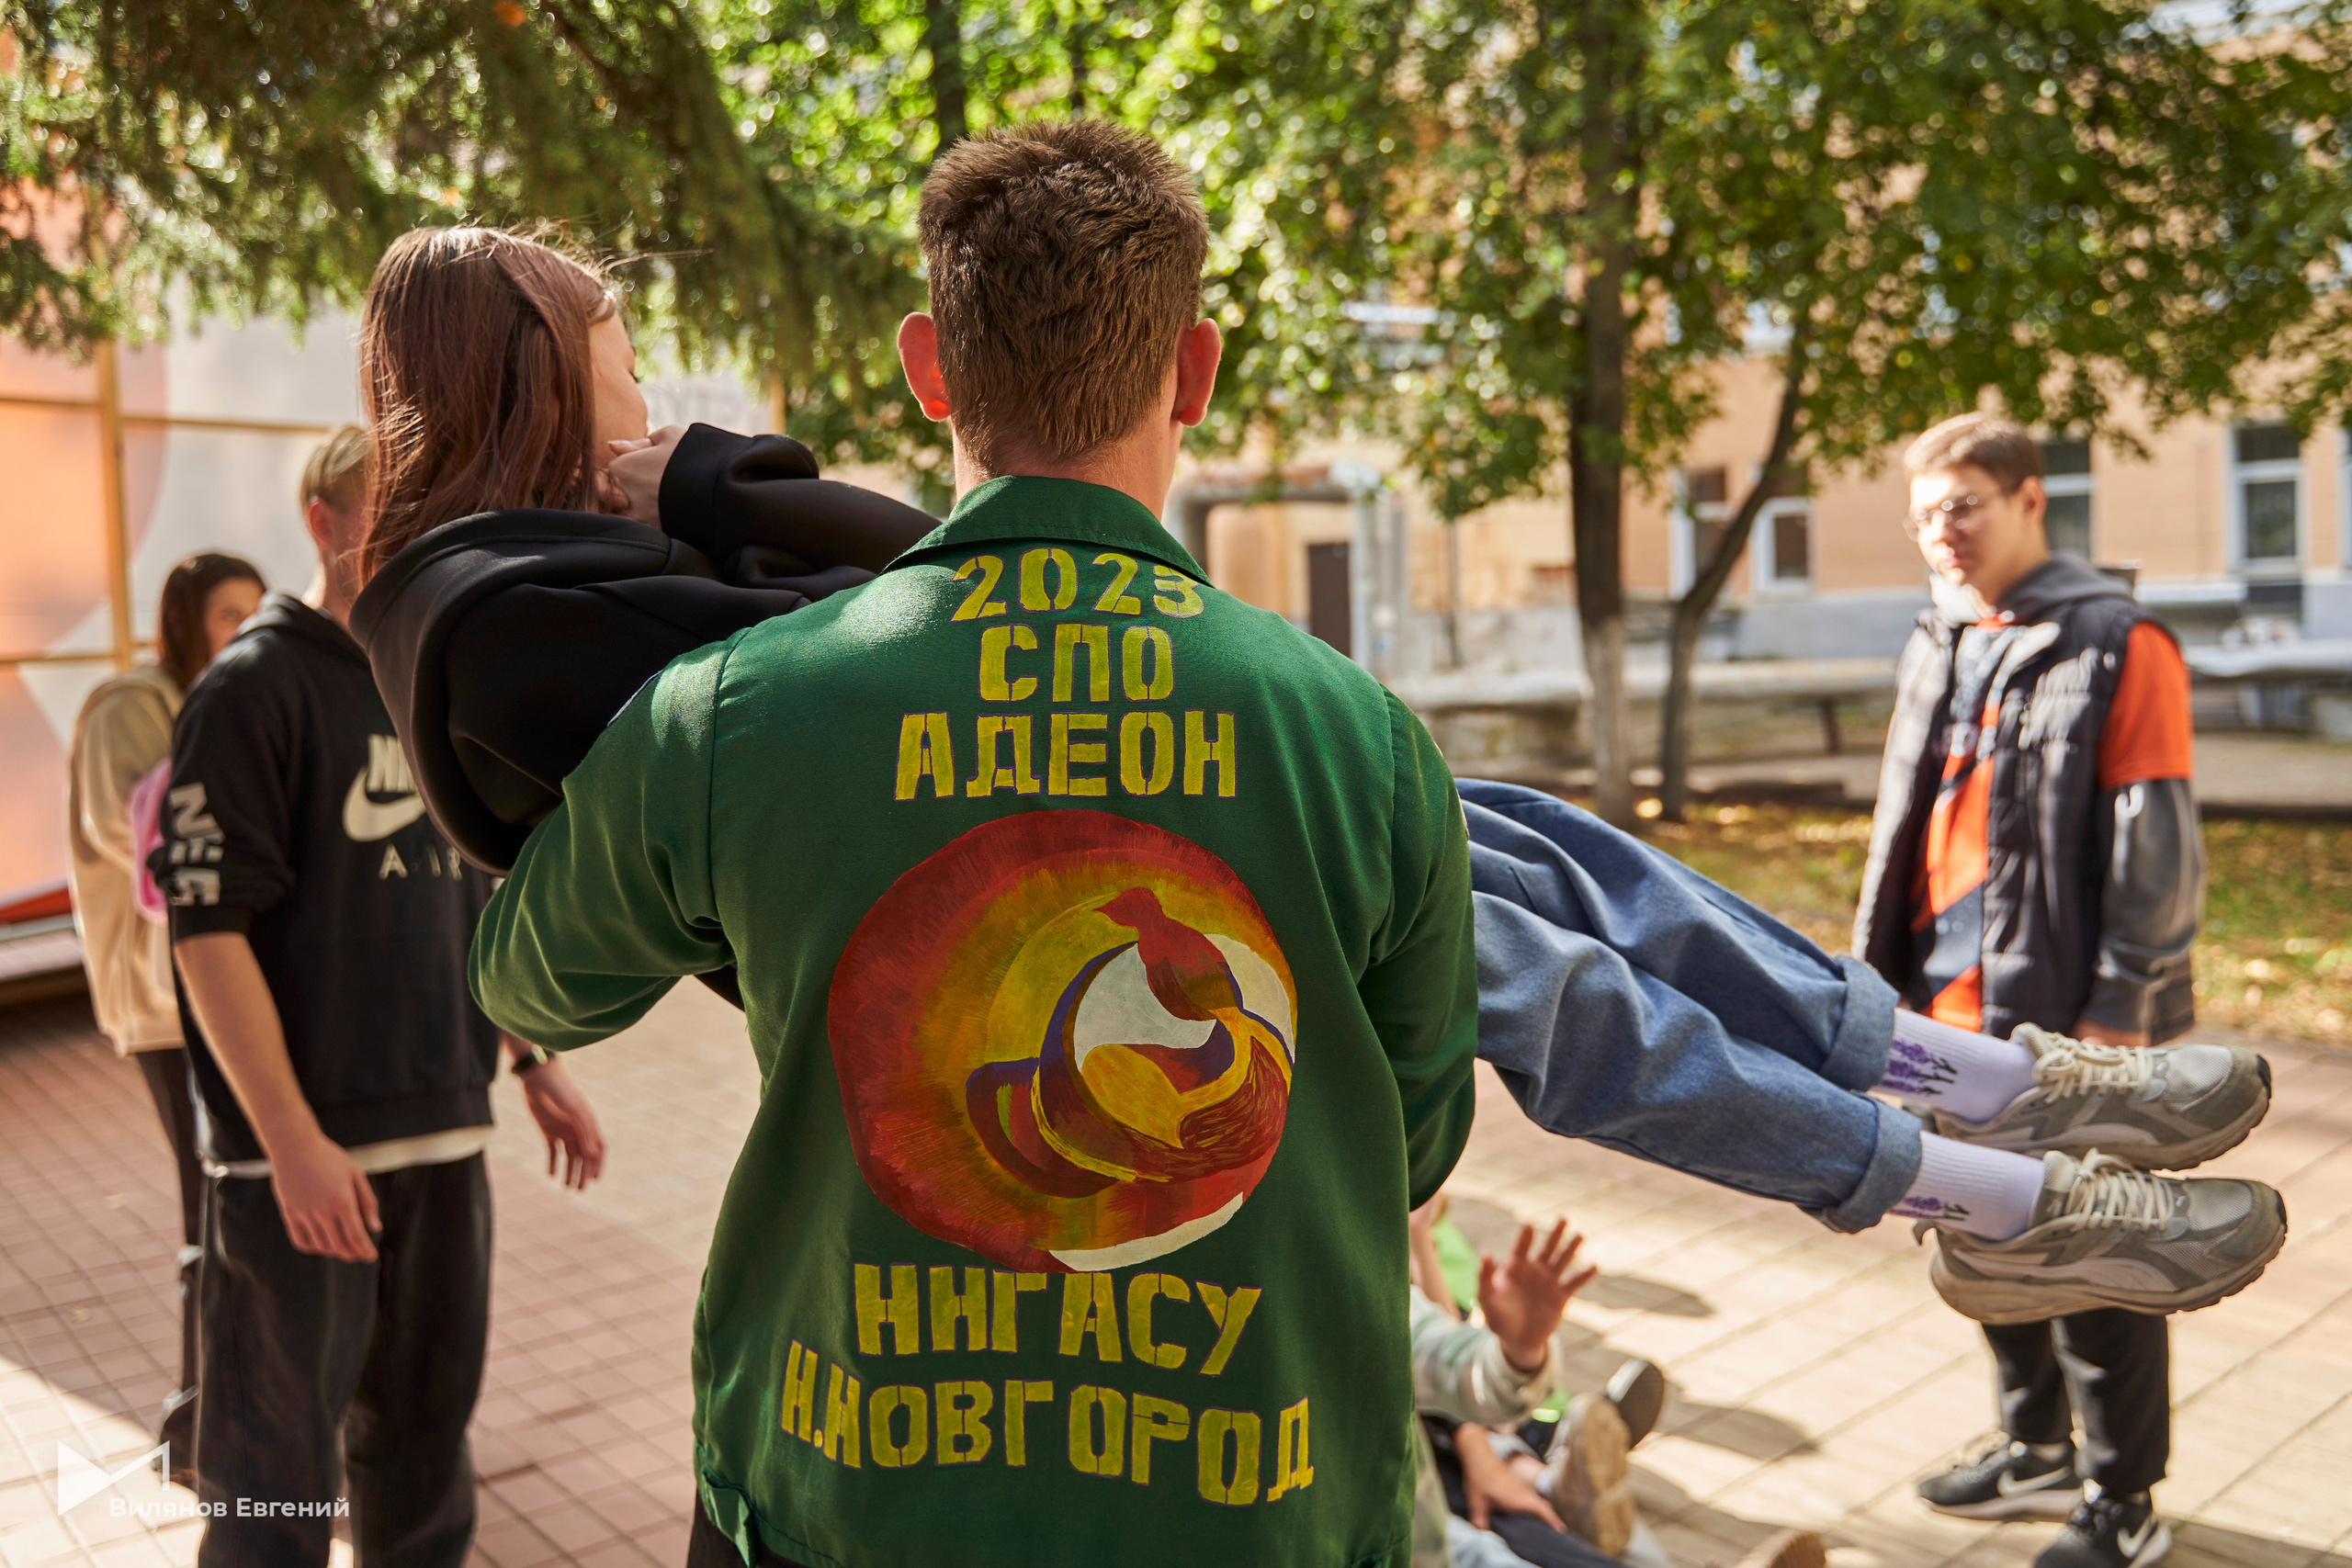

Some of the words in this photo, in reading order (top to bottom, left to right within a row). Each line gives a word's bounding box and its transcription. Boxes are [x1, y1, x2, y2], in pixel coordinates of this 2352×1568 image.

[951, 548, 1204, 622] 2023
[979, 623, 1174, 702] СПО
[894, 709, 1238, 801] АДЕОН
[854, 1261, 1262, 1377] ННГАСУ
